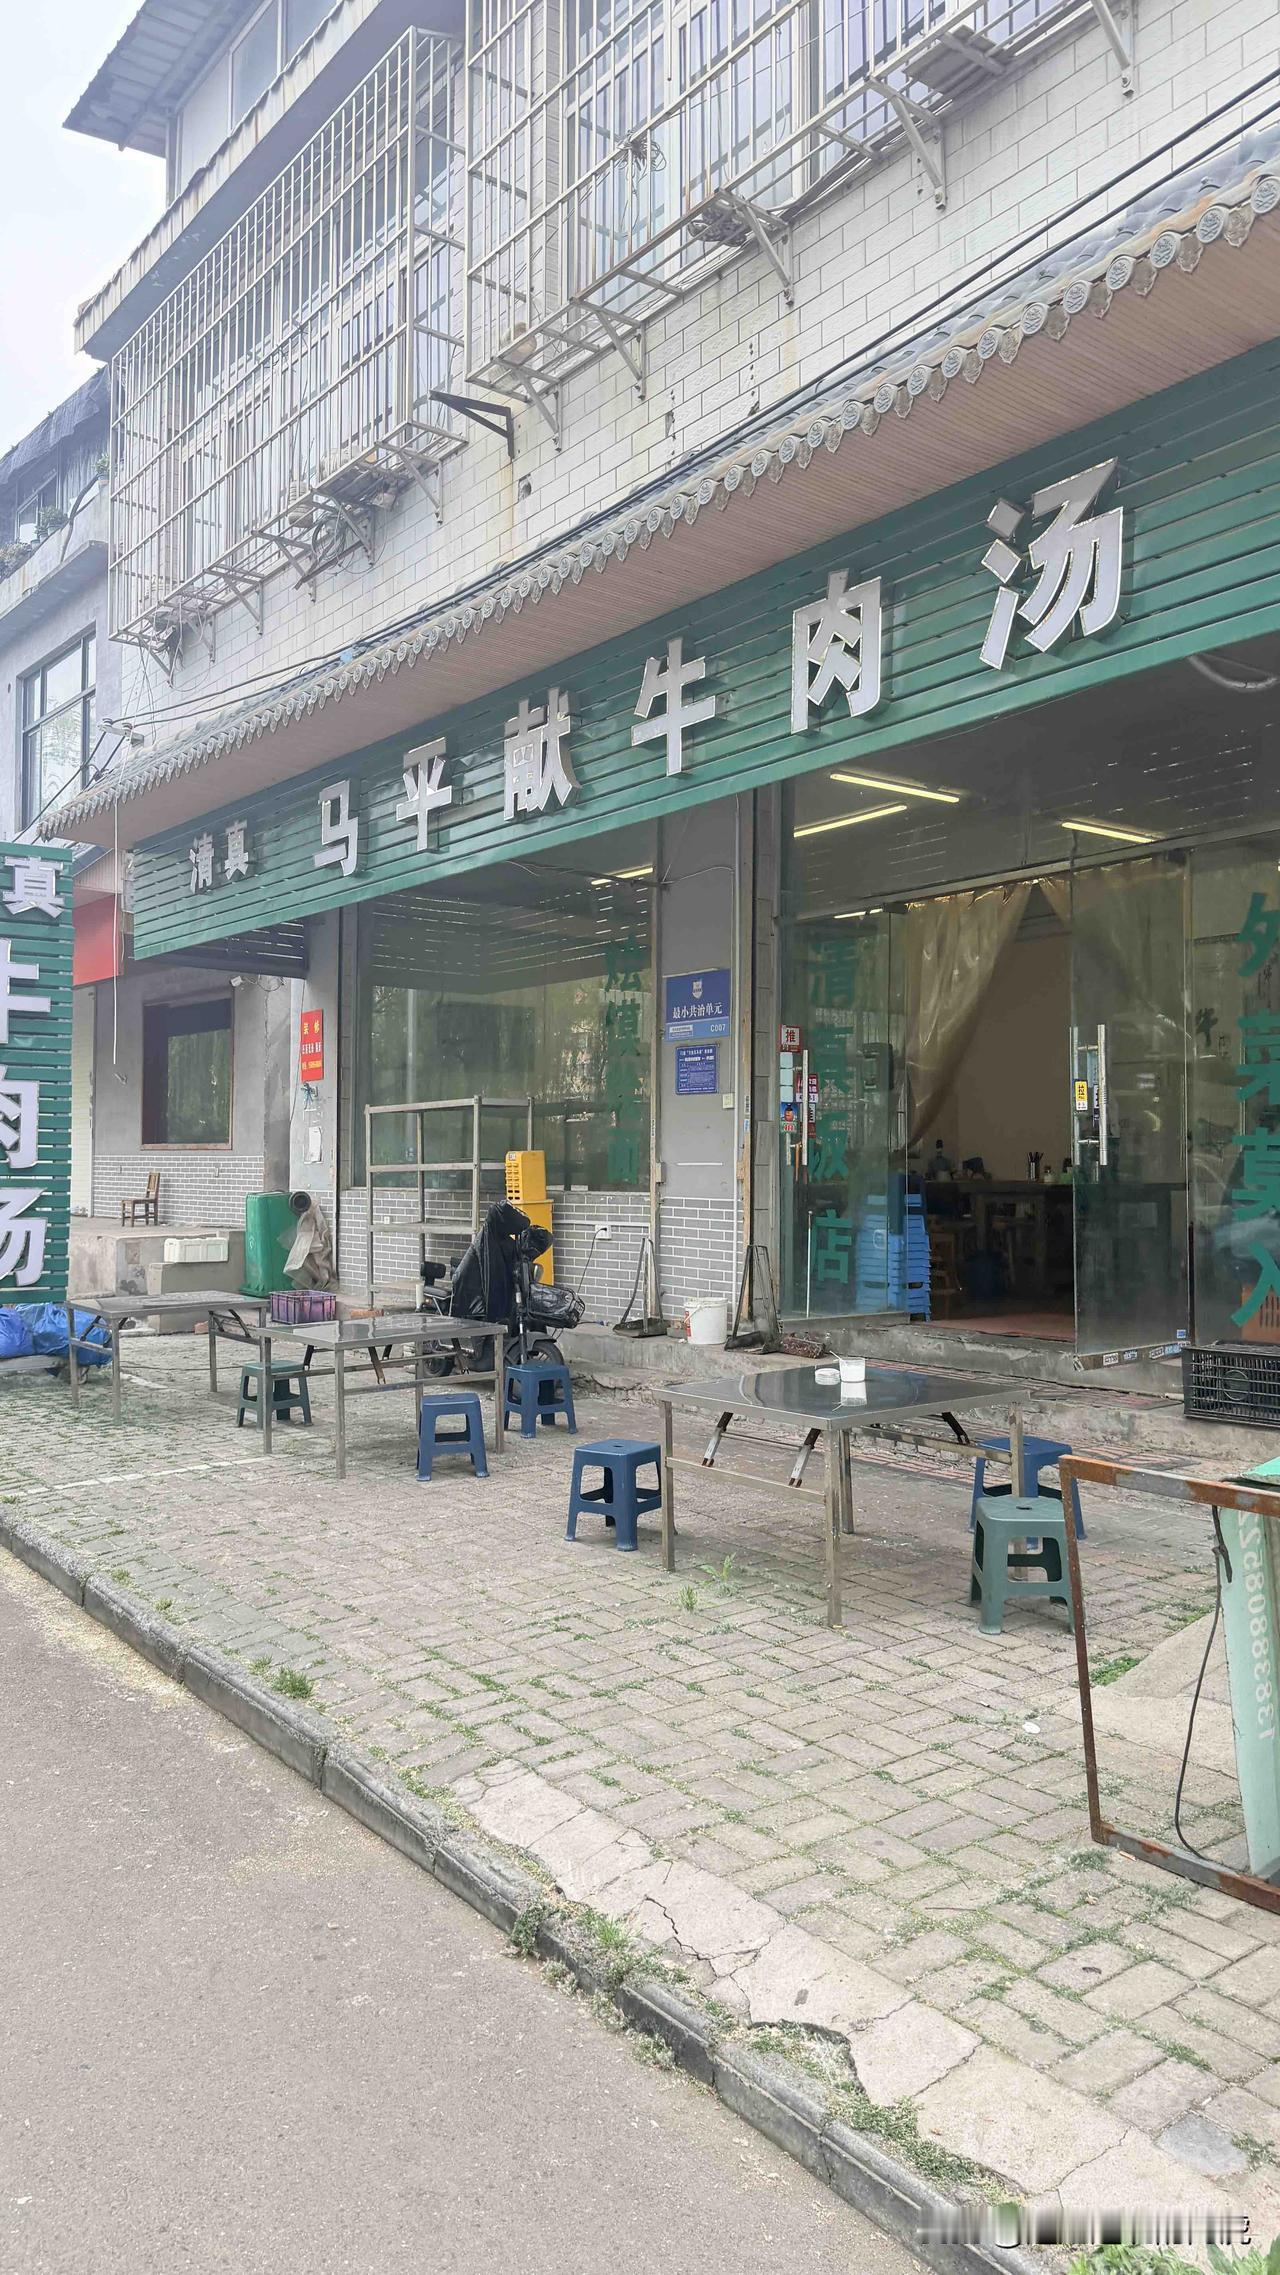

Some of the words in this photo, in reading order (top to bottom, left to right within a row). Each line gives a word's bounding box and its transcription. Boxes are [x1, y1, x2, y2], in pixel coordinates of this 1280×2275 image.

[189, 819, 249, 894] 清真
[313, 457, 1124, 877] 马平献牛肉汤
[3, 856, 65, 919] 真
[672, 1002, 723, 1019] 最小共治单元
[710, 1023, 726, 1033] C007
[785, 1028, 797, 1043] 推
